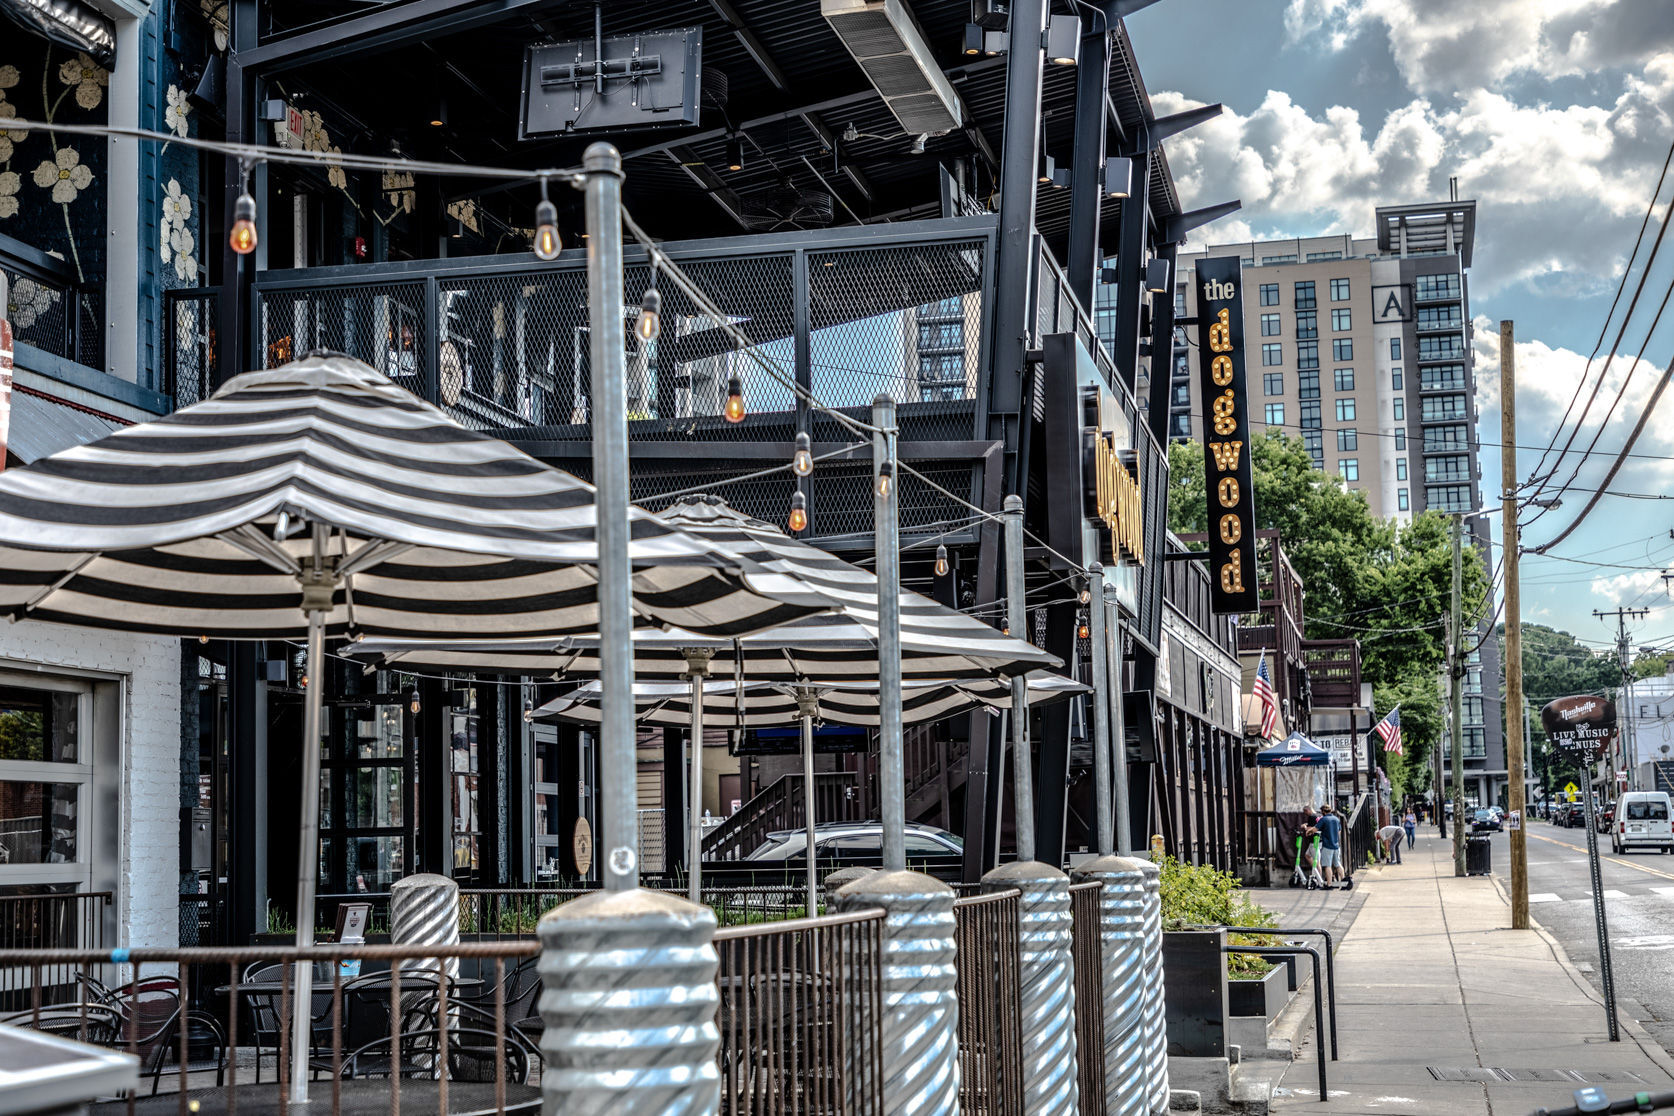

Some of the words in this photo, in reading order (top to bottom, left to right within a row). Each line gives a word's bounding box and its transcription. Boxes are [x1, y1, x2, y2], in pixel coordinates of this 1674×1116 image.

[290, 110, 302, 137] EXIT
[1203, 278, 1235, 300] the
[1381, 290, 1405, 317] A
[1209, 307, 1245, 594] dogwood
[1560, 701, 1596, 720] Nashville
[1335, 738, 1359, 749] REB
[1553, 731, 1576, 741] LIVE
[1578, 728, 1609, 739] MUSIC
[1564, 739, 1601, 750] ENUES
[1280, 754, 1304, 765] Miller
